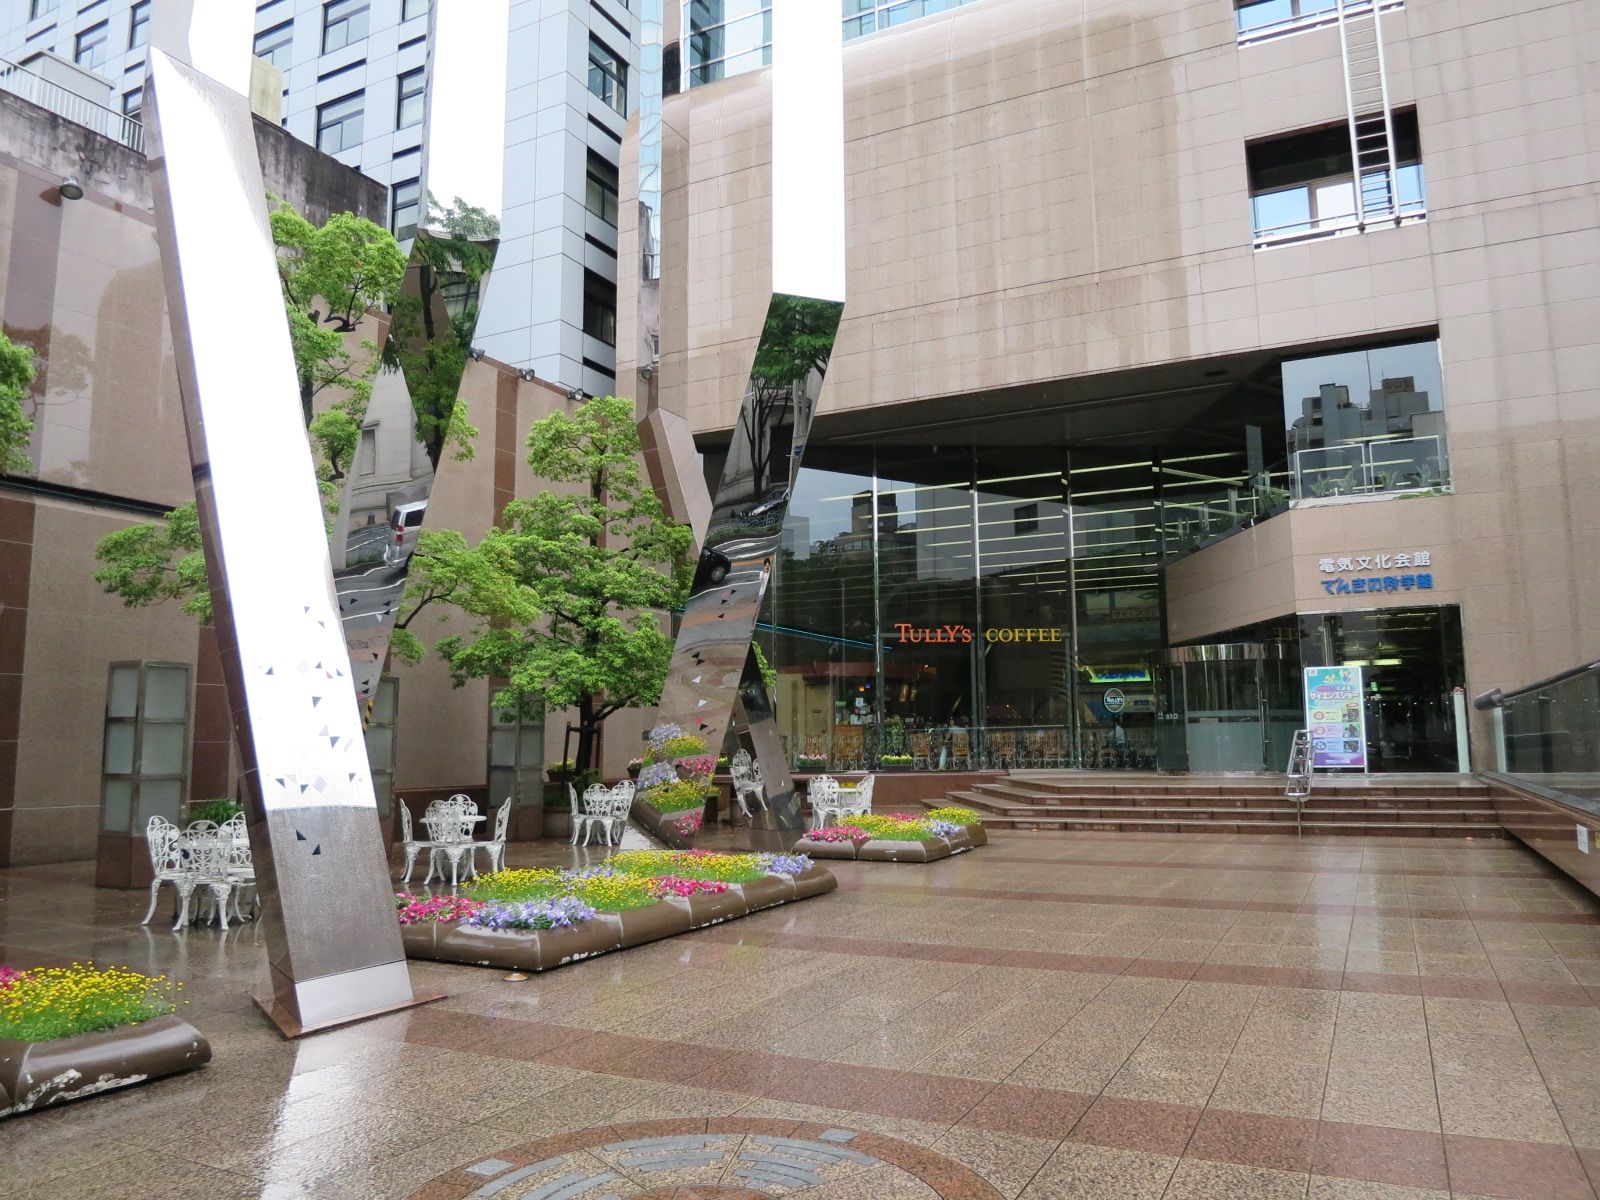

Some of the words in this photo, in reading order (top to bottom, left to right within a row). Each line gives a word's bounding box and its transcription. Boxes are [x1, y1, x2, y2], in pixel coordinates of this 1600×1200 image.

[1318, 551, 1431, 573] 電気文化会館
[1320, 573, 1433, 595] でんきの科学館
[985, 628, 1062, 643] COFFEE
